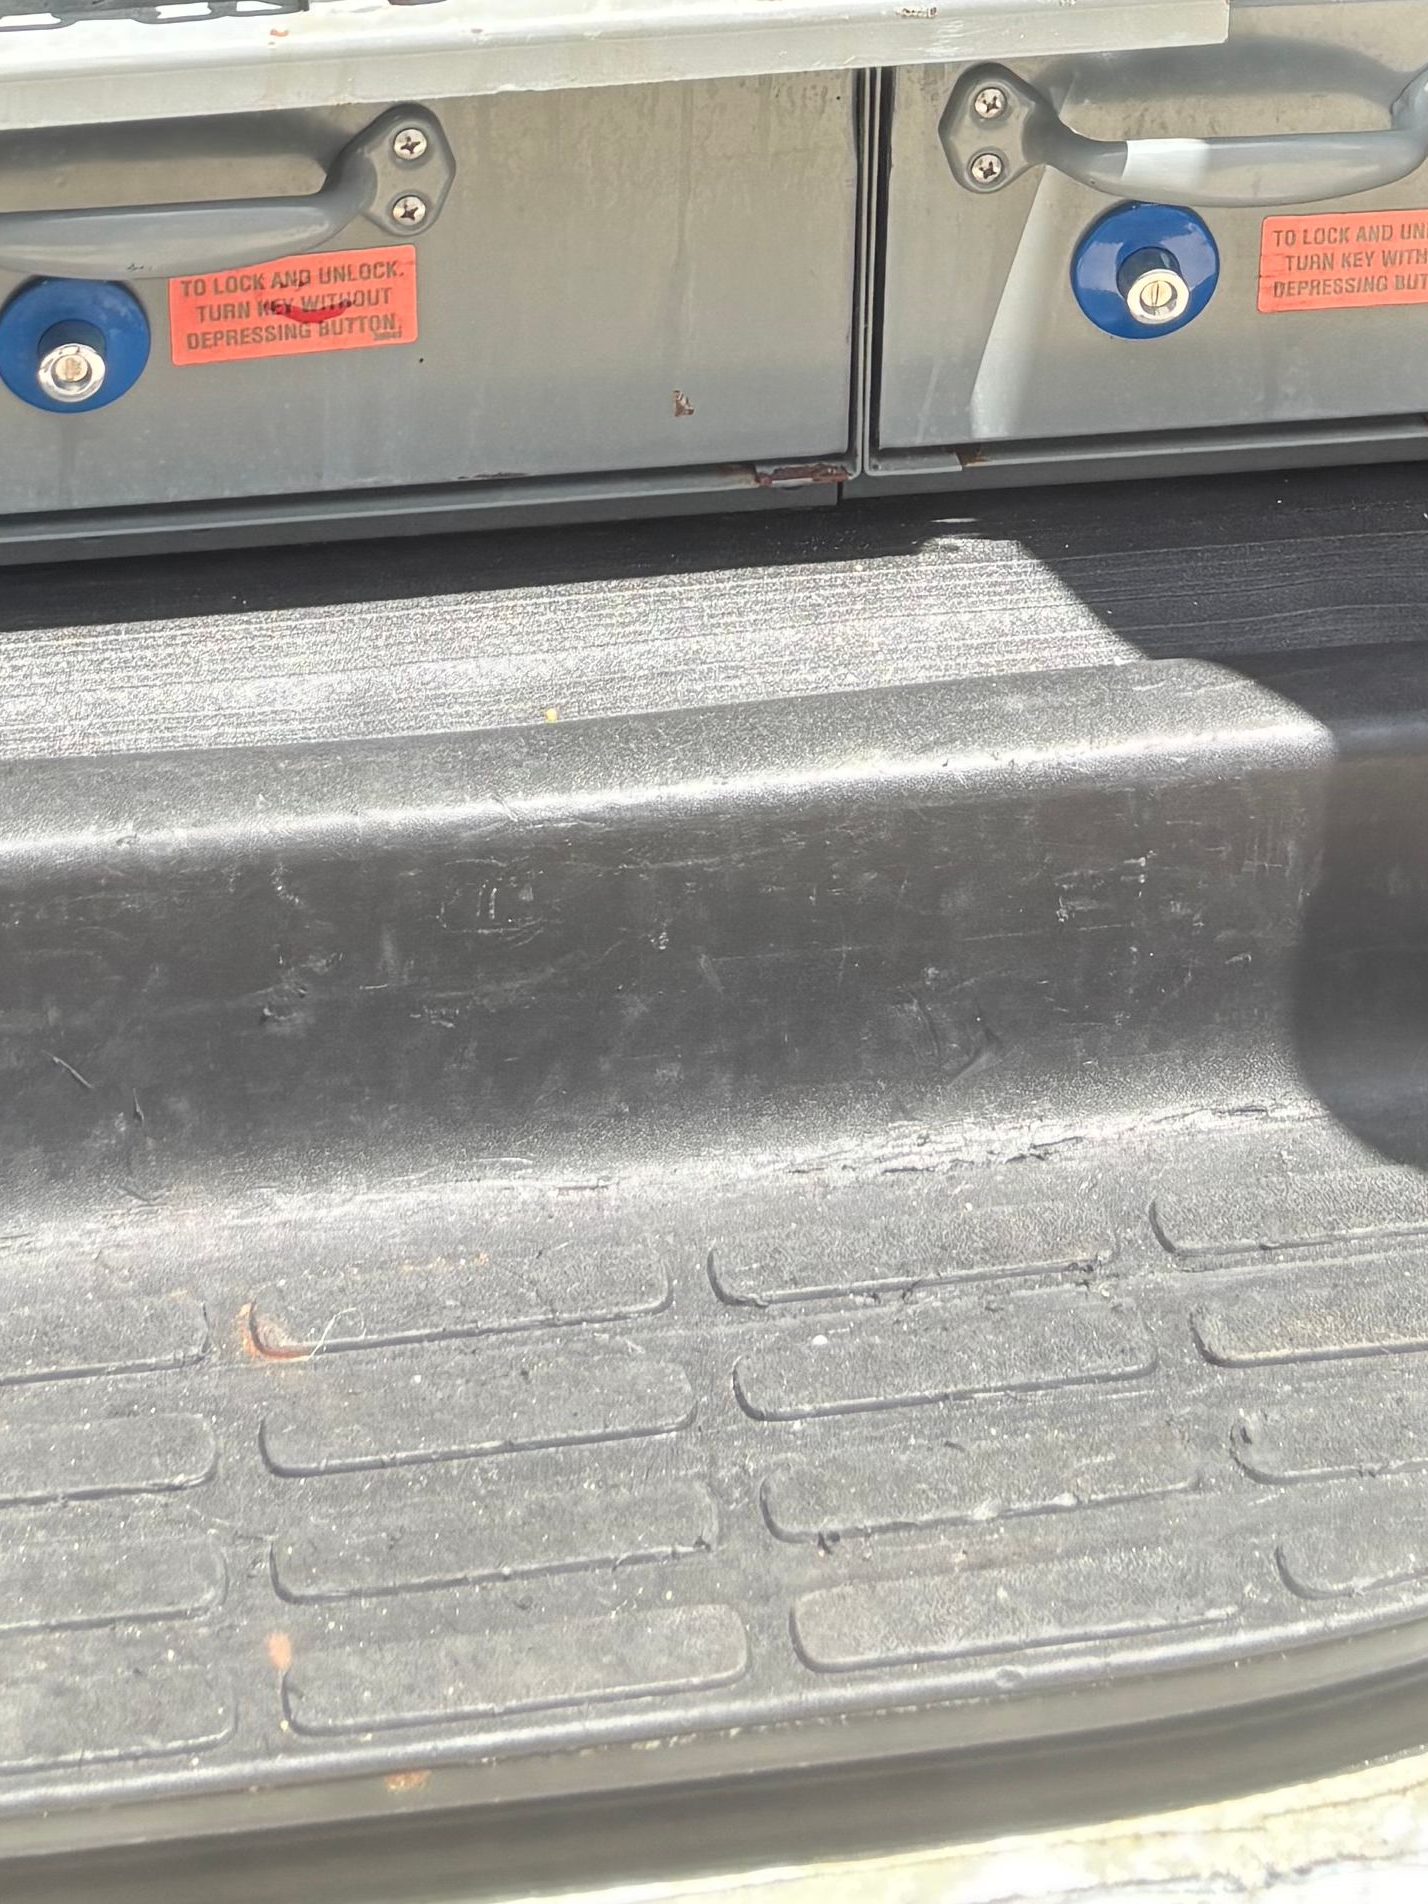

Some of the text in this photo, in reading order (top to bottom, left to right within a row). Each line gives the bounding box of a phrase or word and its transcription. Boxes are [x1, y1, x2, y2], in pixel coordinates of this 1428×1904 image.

[1273, 230, 1297, 247] TO
[1302, 227, 1351, 245] LOCK
[1355, 224, 1394, 242] AND
[1285, 253, 1335, 272] TURN
[1341, 250, 1376, 269] KEY
[180, 279, 206, 297] TO
[213, 274, 266, 293] LOCK
[270, 269, 311, 289] AND
[1273, 275, 1389, 298] DEPRESSING
[196, 287, 393, 322] TURN KEY WITHOUT
[187, 323, 311, 350] DEPRESSING
